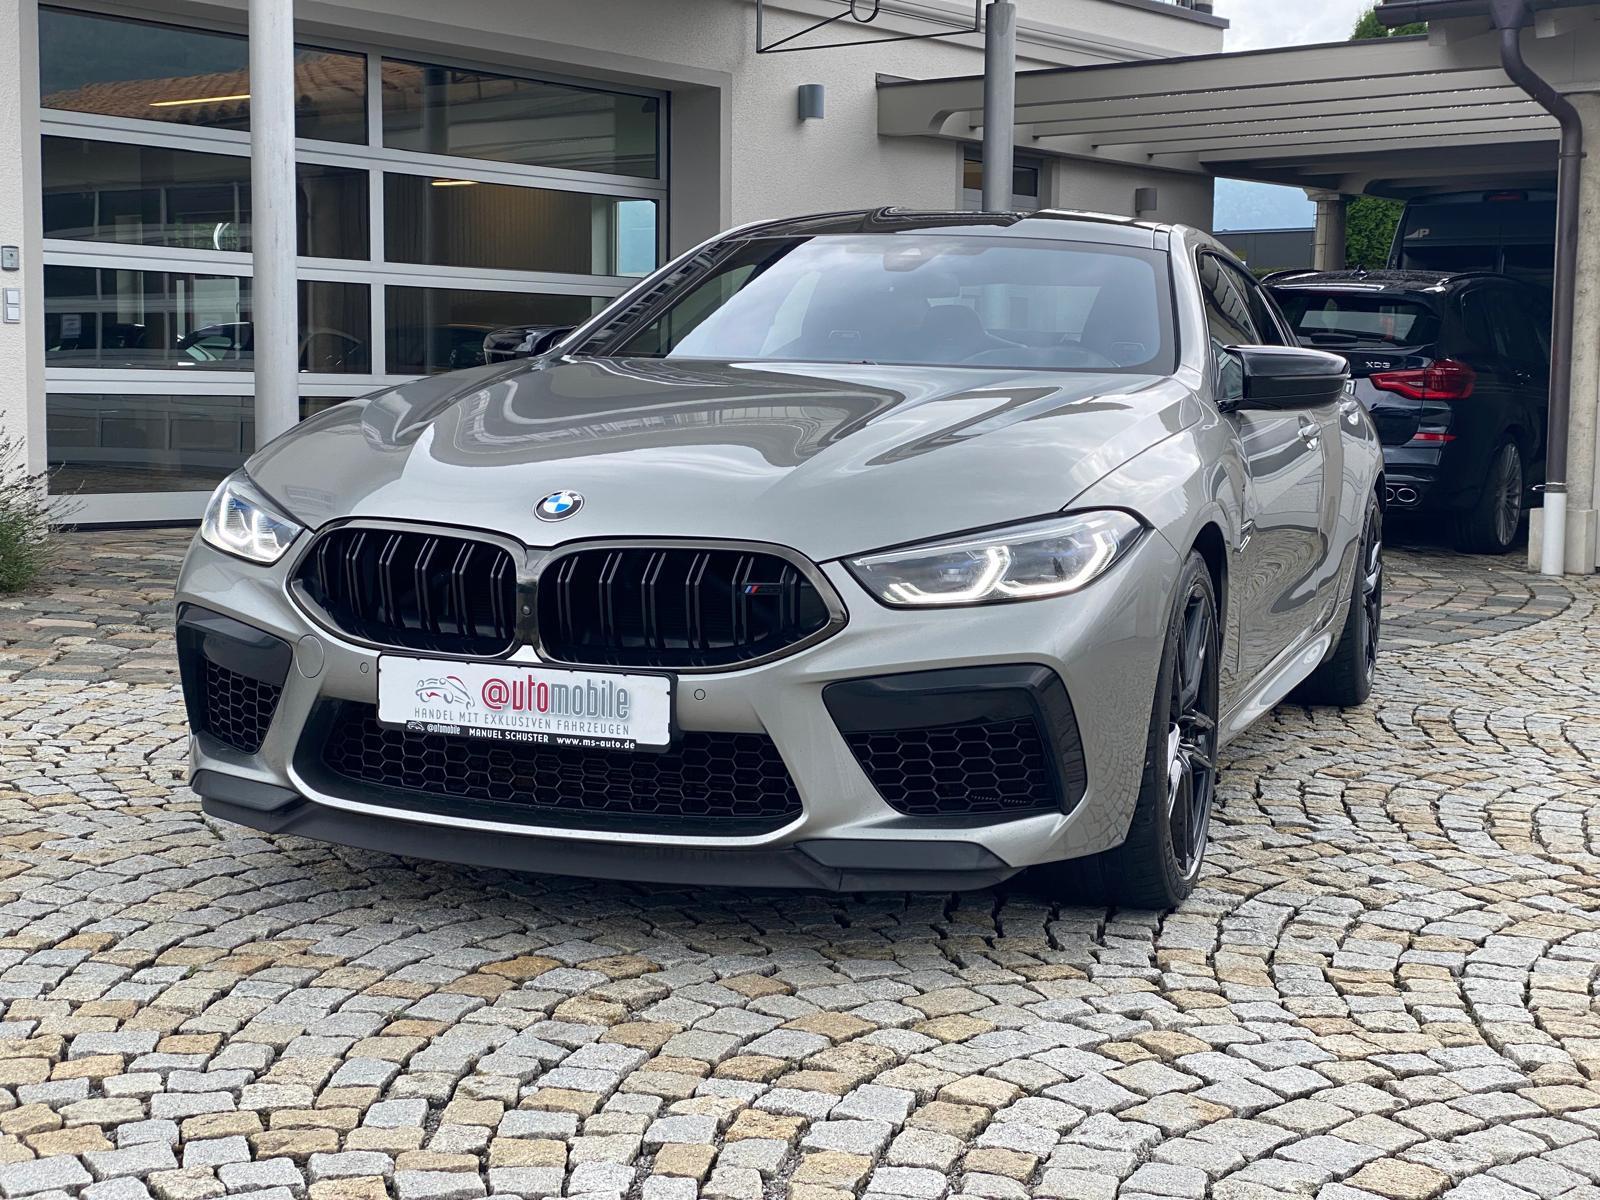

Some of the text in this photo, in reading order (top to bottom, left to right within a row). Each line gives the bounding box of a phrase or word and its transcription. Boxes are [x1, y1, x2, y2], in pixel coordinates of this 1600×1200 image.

[414, 707, 629, 735] HANDEL MIT EXKLUSIVEN FAHRZEUGEN
[469, 728, 502, 739] MANUEL
[505, 732, 549, 743] SCHUSTER
[556, 736, 635, 749] www.ms-auto.de
